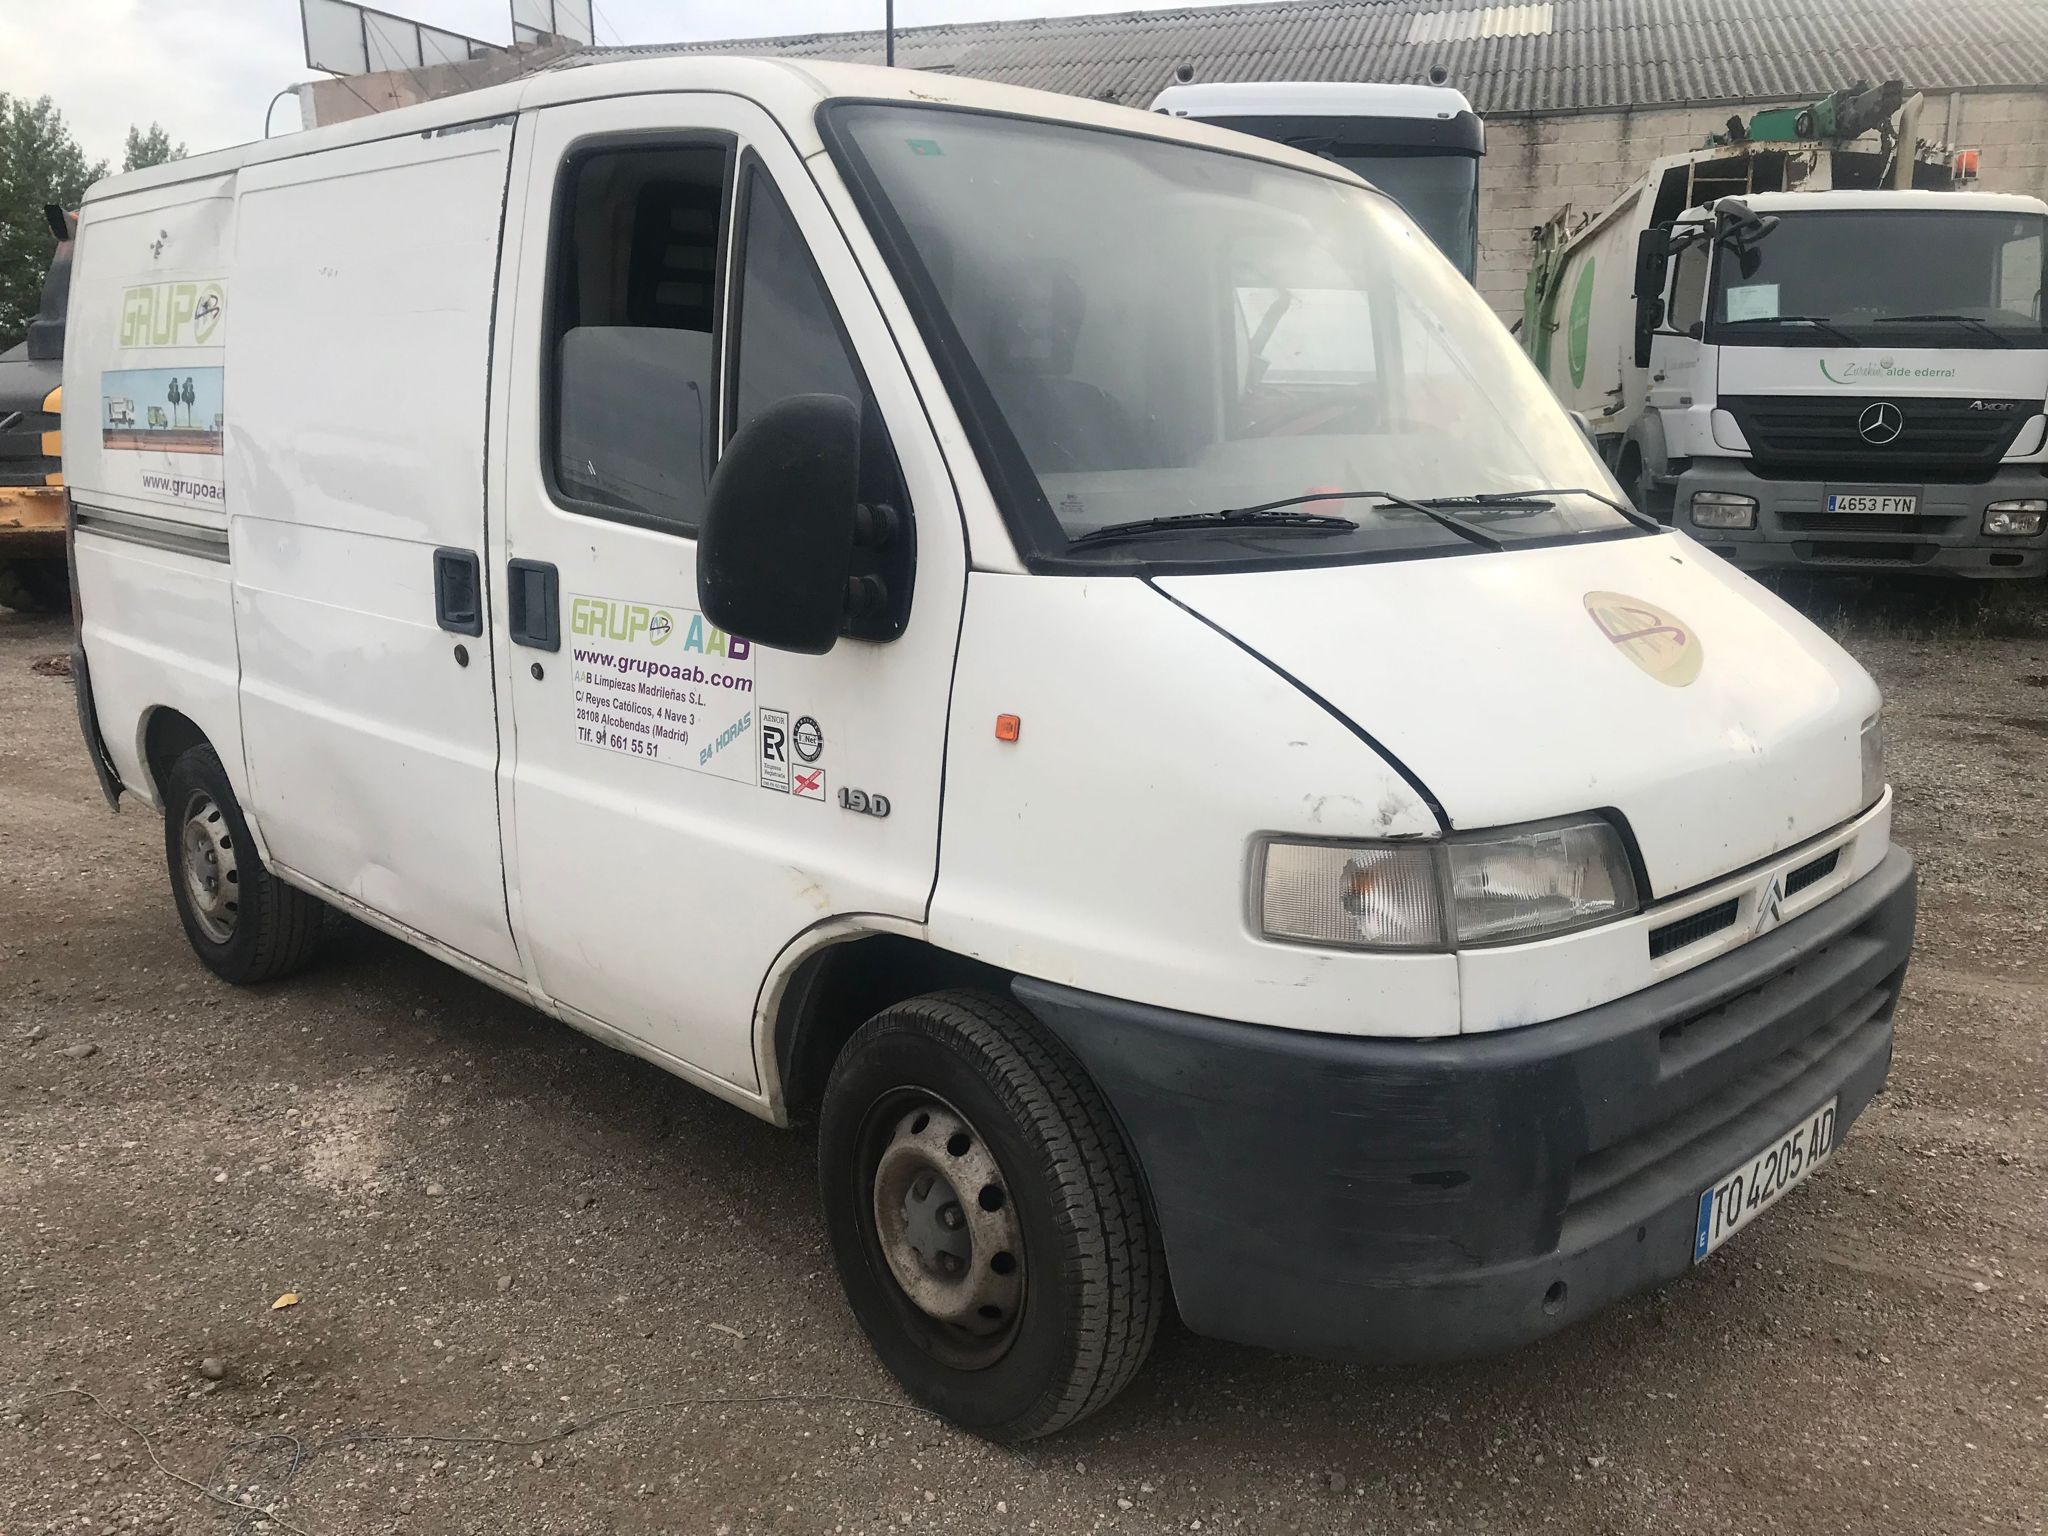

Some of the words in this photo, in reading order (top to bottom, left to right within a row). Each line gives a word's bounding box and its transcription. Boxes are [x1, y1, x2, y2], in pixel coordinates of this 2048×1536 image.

[1887, 368, 1911, 377] alde
[1915, 368, 1955, 377] ederra!
[1838, 498, 1877, 511] 4653
[1882, 498, 1912, 512] FYN
[574, 649, 753, 692] www.grupoaab.com
[575, 670, 592, 684] AAB
[594, 674, 636, 692] Limpiezas
[638, 682, 686, 702] Madrileñas
[688, 692, 706, 707] S.L.
[575, 690, 585, 702] C/
[586, 692, 610, 708] Reyes
[612, 697, 655, 719] Católicos,
[656, 707, 662, 719] 4
[664, 708, 687, 724] Nave
[689, 713, 695, 725] 3
[576, 708, 600, 723] 28108
[600, 713, 650, 735] Alcobendas
[652, 725, 689, 745] (Madrid)
[700, 743, 713, 766] 24
[716, 712, 751, 753] HORAS
[610, 734, 628, 751] 661
[631, 739, 644, 754] 55
[646, 742, 658, 758] 51
[1714, 1175, 1743, 1239] TO
[1746, 1129, 1804, 1209] 4205
[1806, 1107, 1834, 1168] AD
